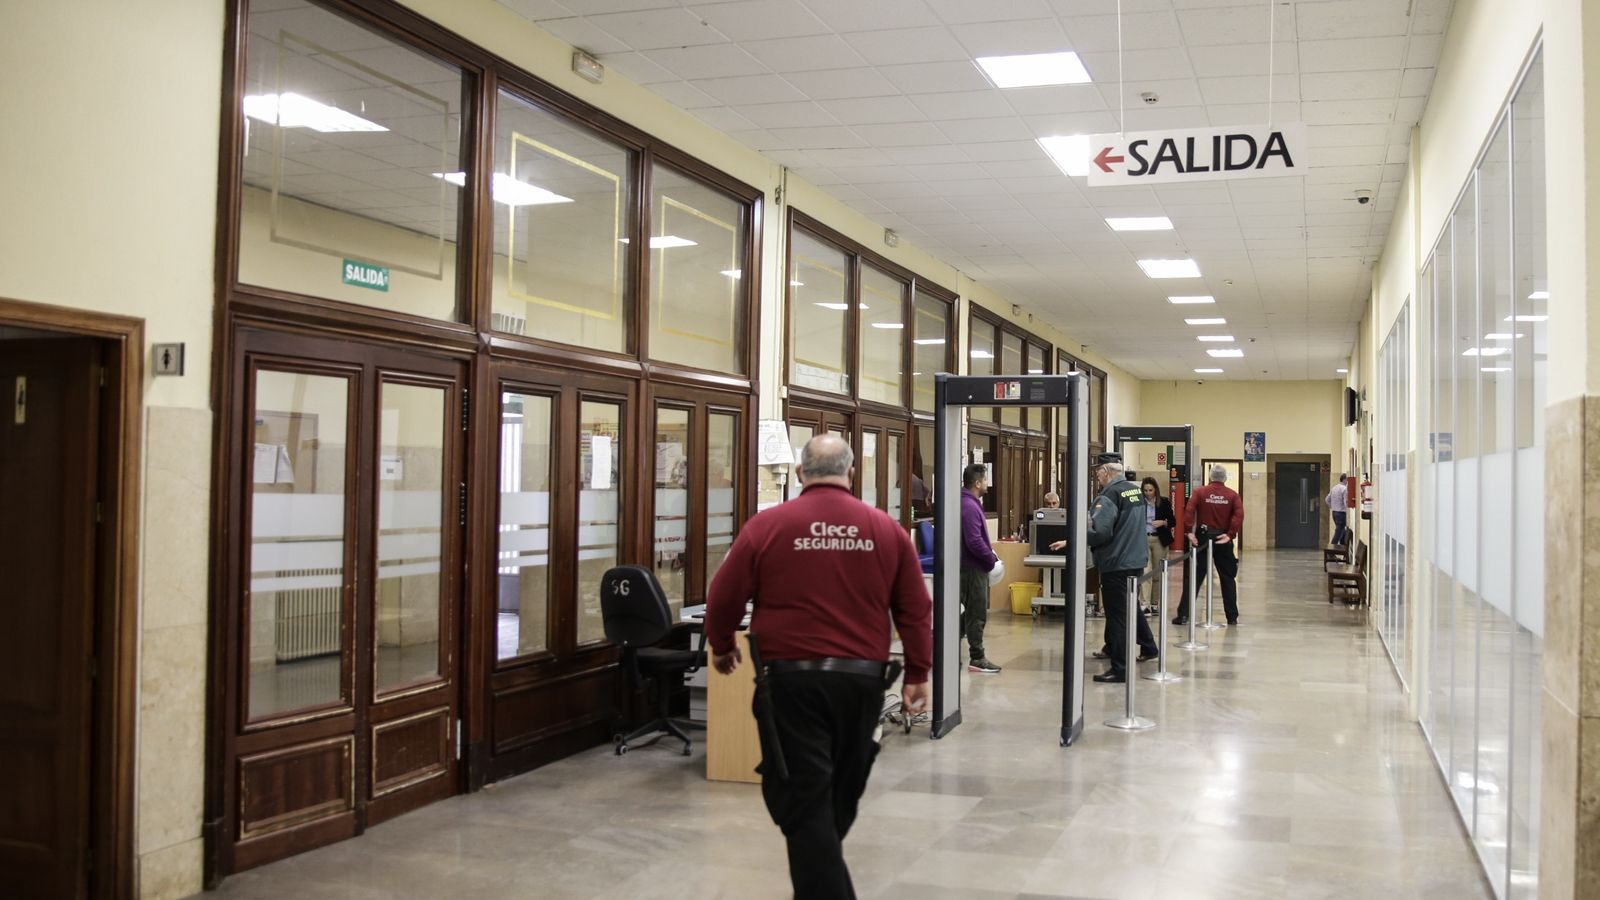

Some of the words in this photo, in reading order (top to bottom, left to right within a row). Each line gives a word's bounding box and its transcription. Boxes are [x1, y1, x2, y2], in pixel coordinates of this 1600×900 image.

[1127, 131, 1295, 177] SALIDA
[345, 263, 385, 286] SALIDA
[810, 521, 859, 537] Clece
[793, 537, 874, 551] SEGURIDAD
